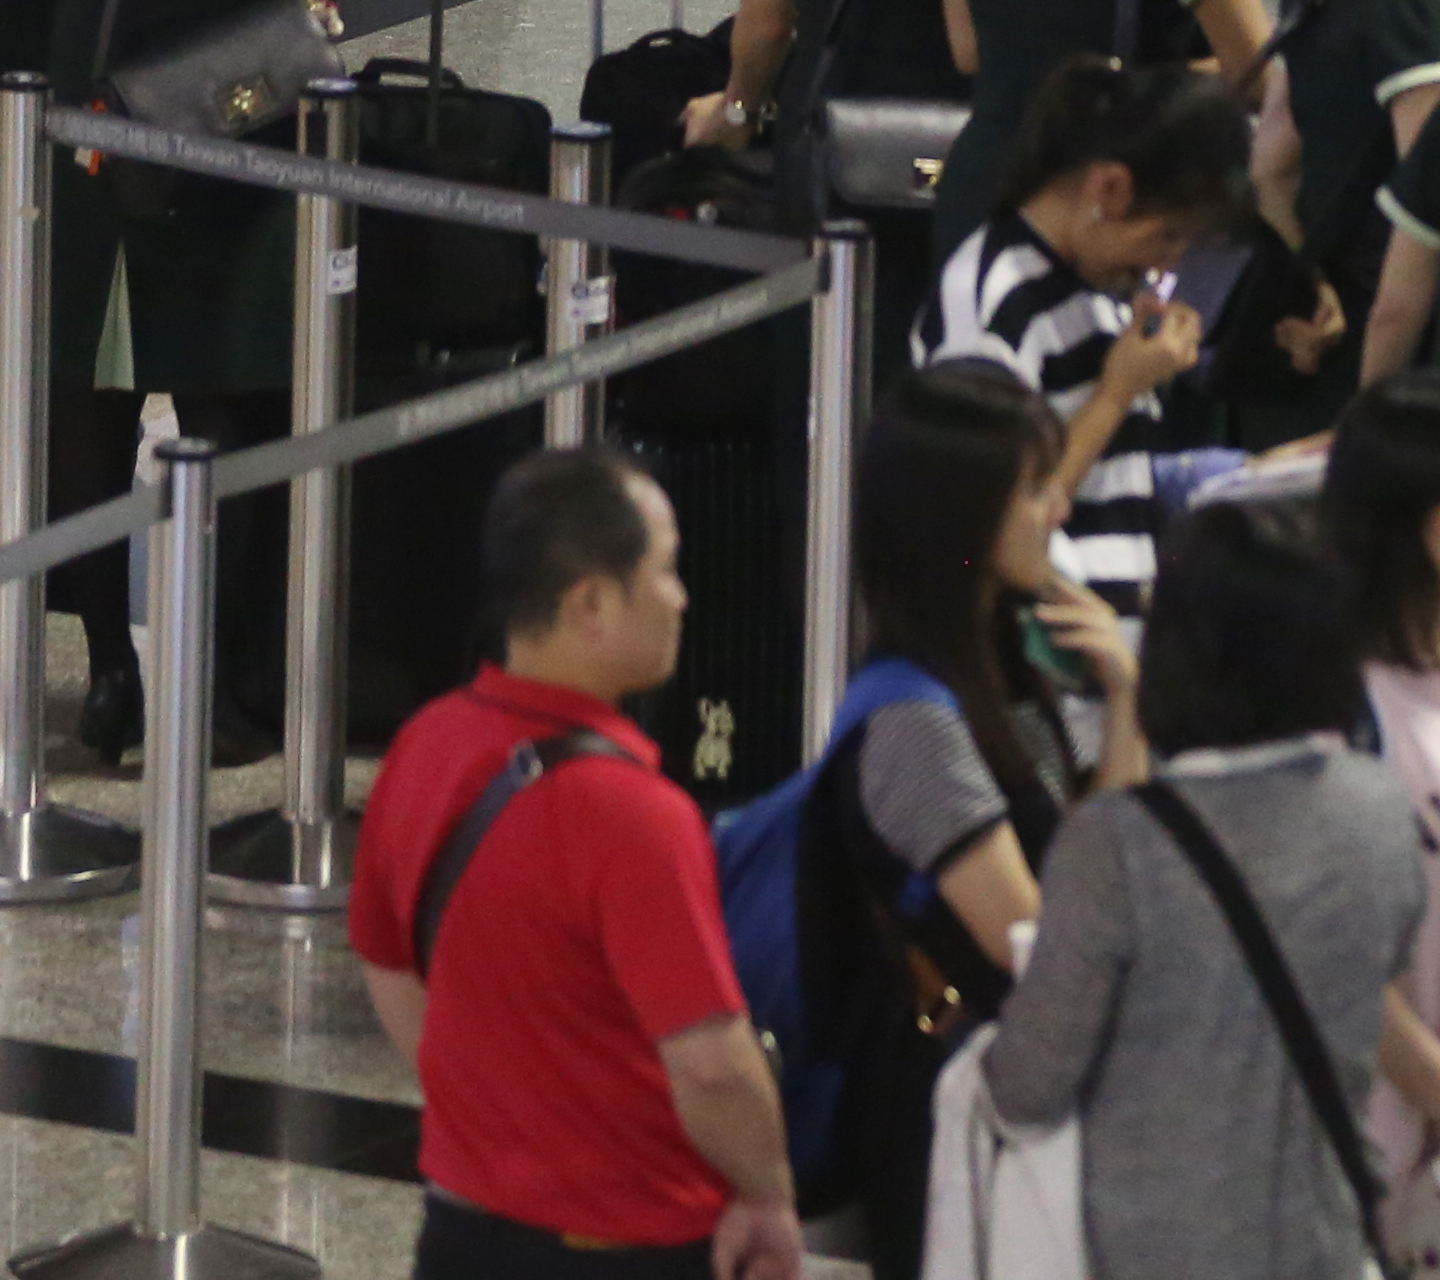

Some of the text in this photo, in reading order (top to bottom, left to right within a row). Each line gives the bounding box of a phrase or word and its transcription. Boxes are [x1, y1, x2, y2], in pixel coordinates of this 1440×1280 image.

[171, 133, 526, 225] Taiwan Taoyuan International Airport
